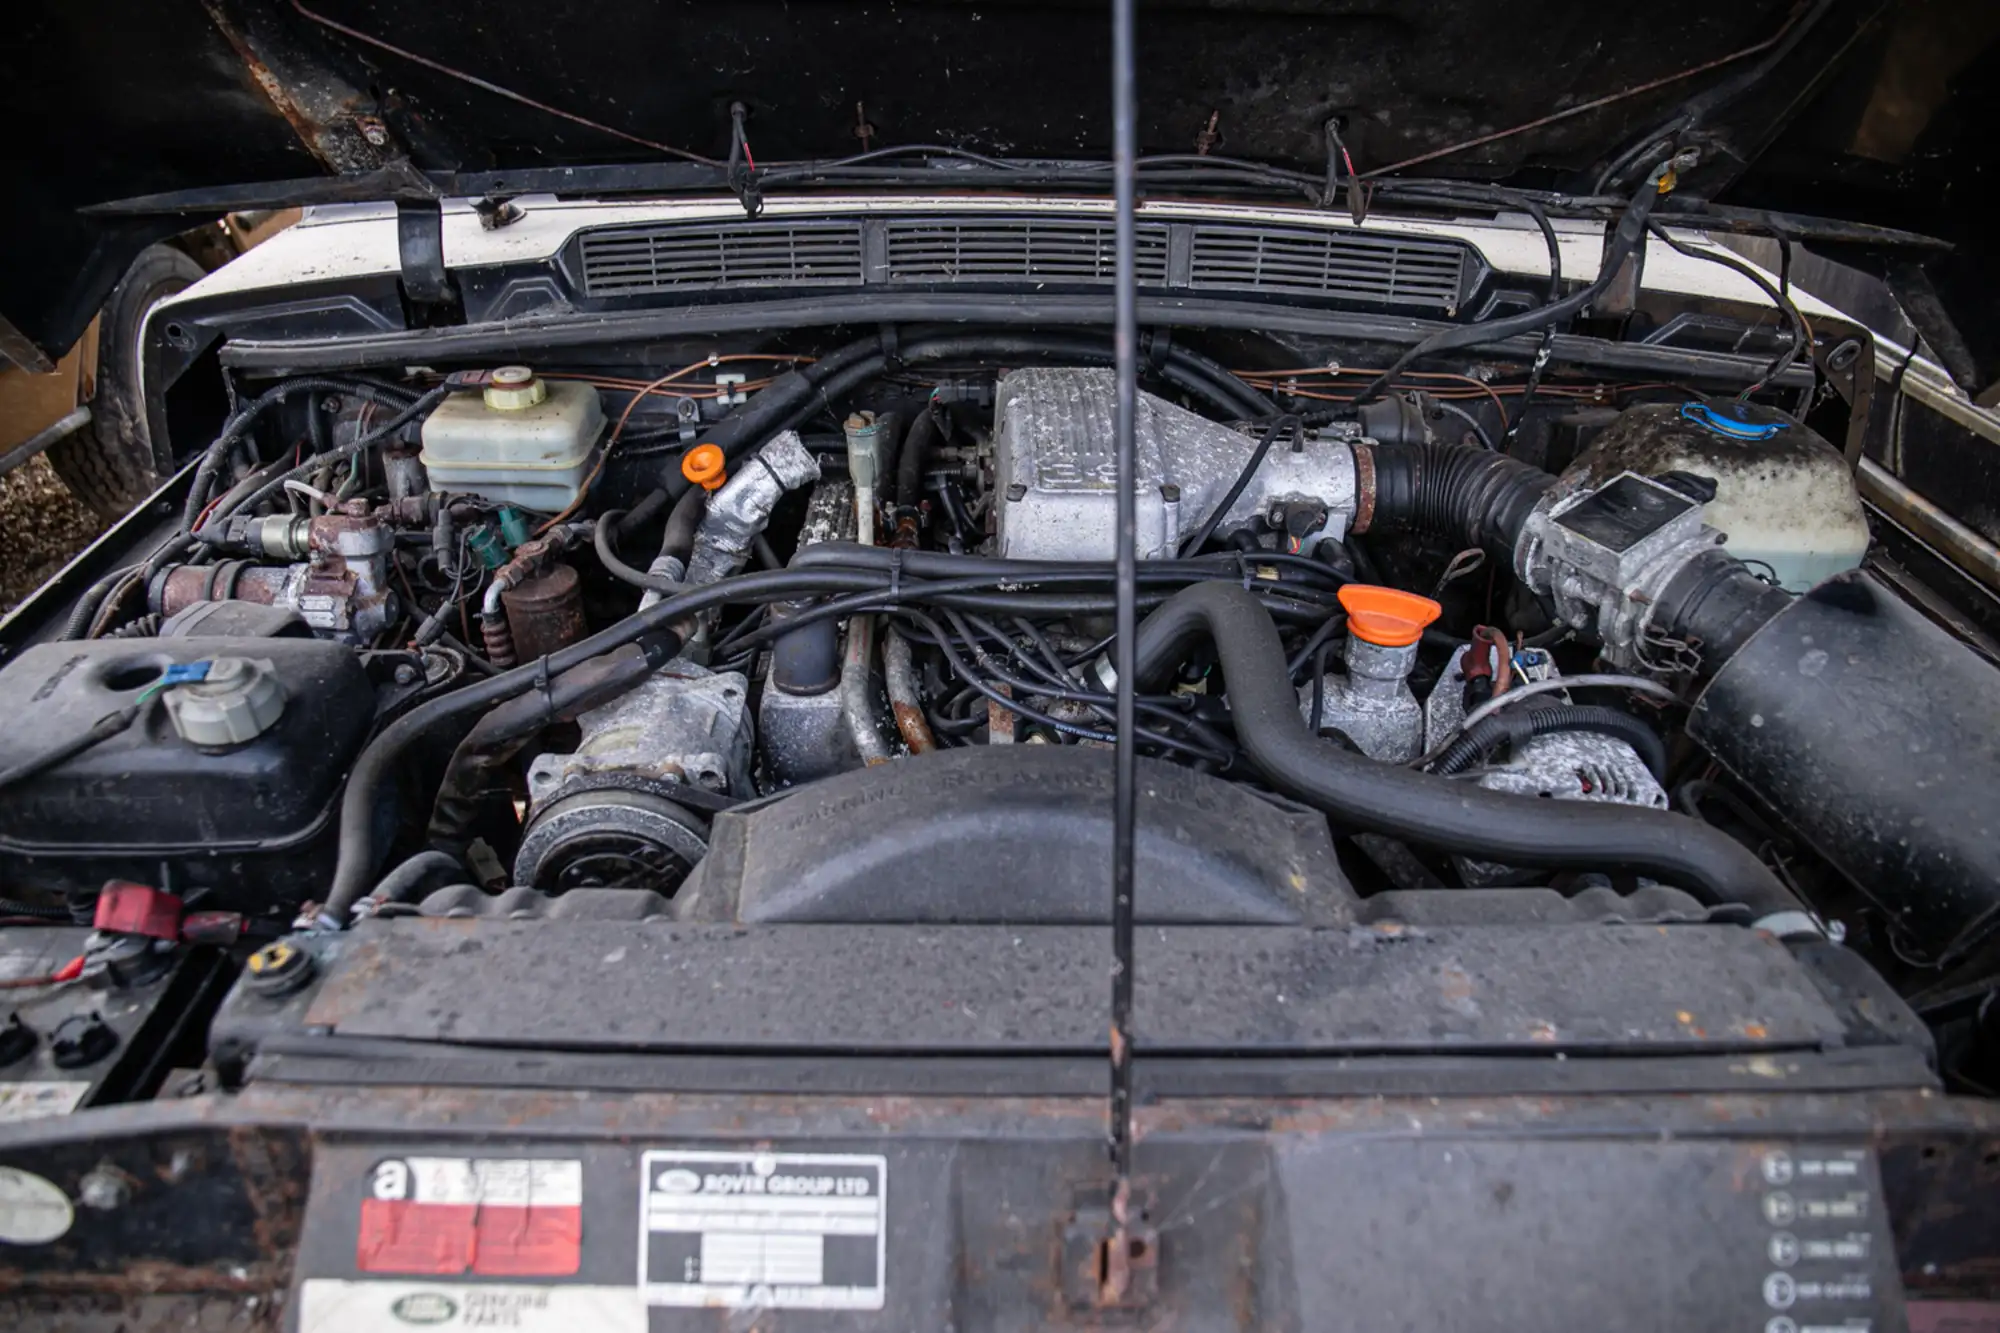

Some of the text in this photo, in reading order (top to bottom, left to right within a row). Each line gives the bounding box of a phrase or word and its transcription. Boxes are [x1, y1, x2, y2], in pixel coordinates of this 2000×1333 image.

[373, 1160, 408, 1200] a
[767, 1175, 834, 1195] GROUP
[836, 1177, 870, 1196] LTD
